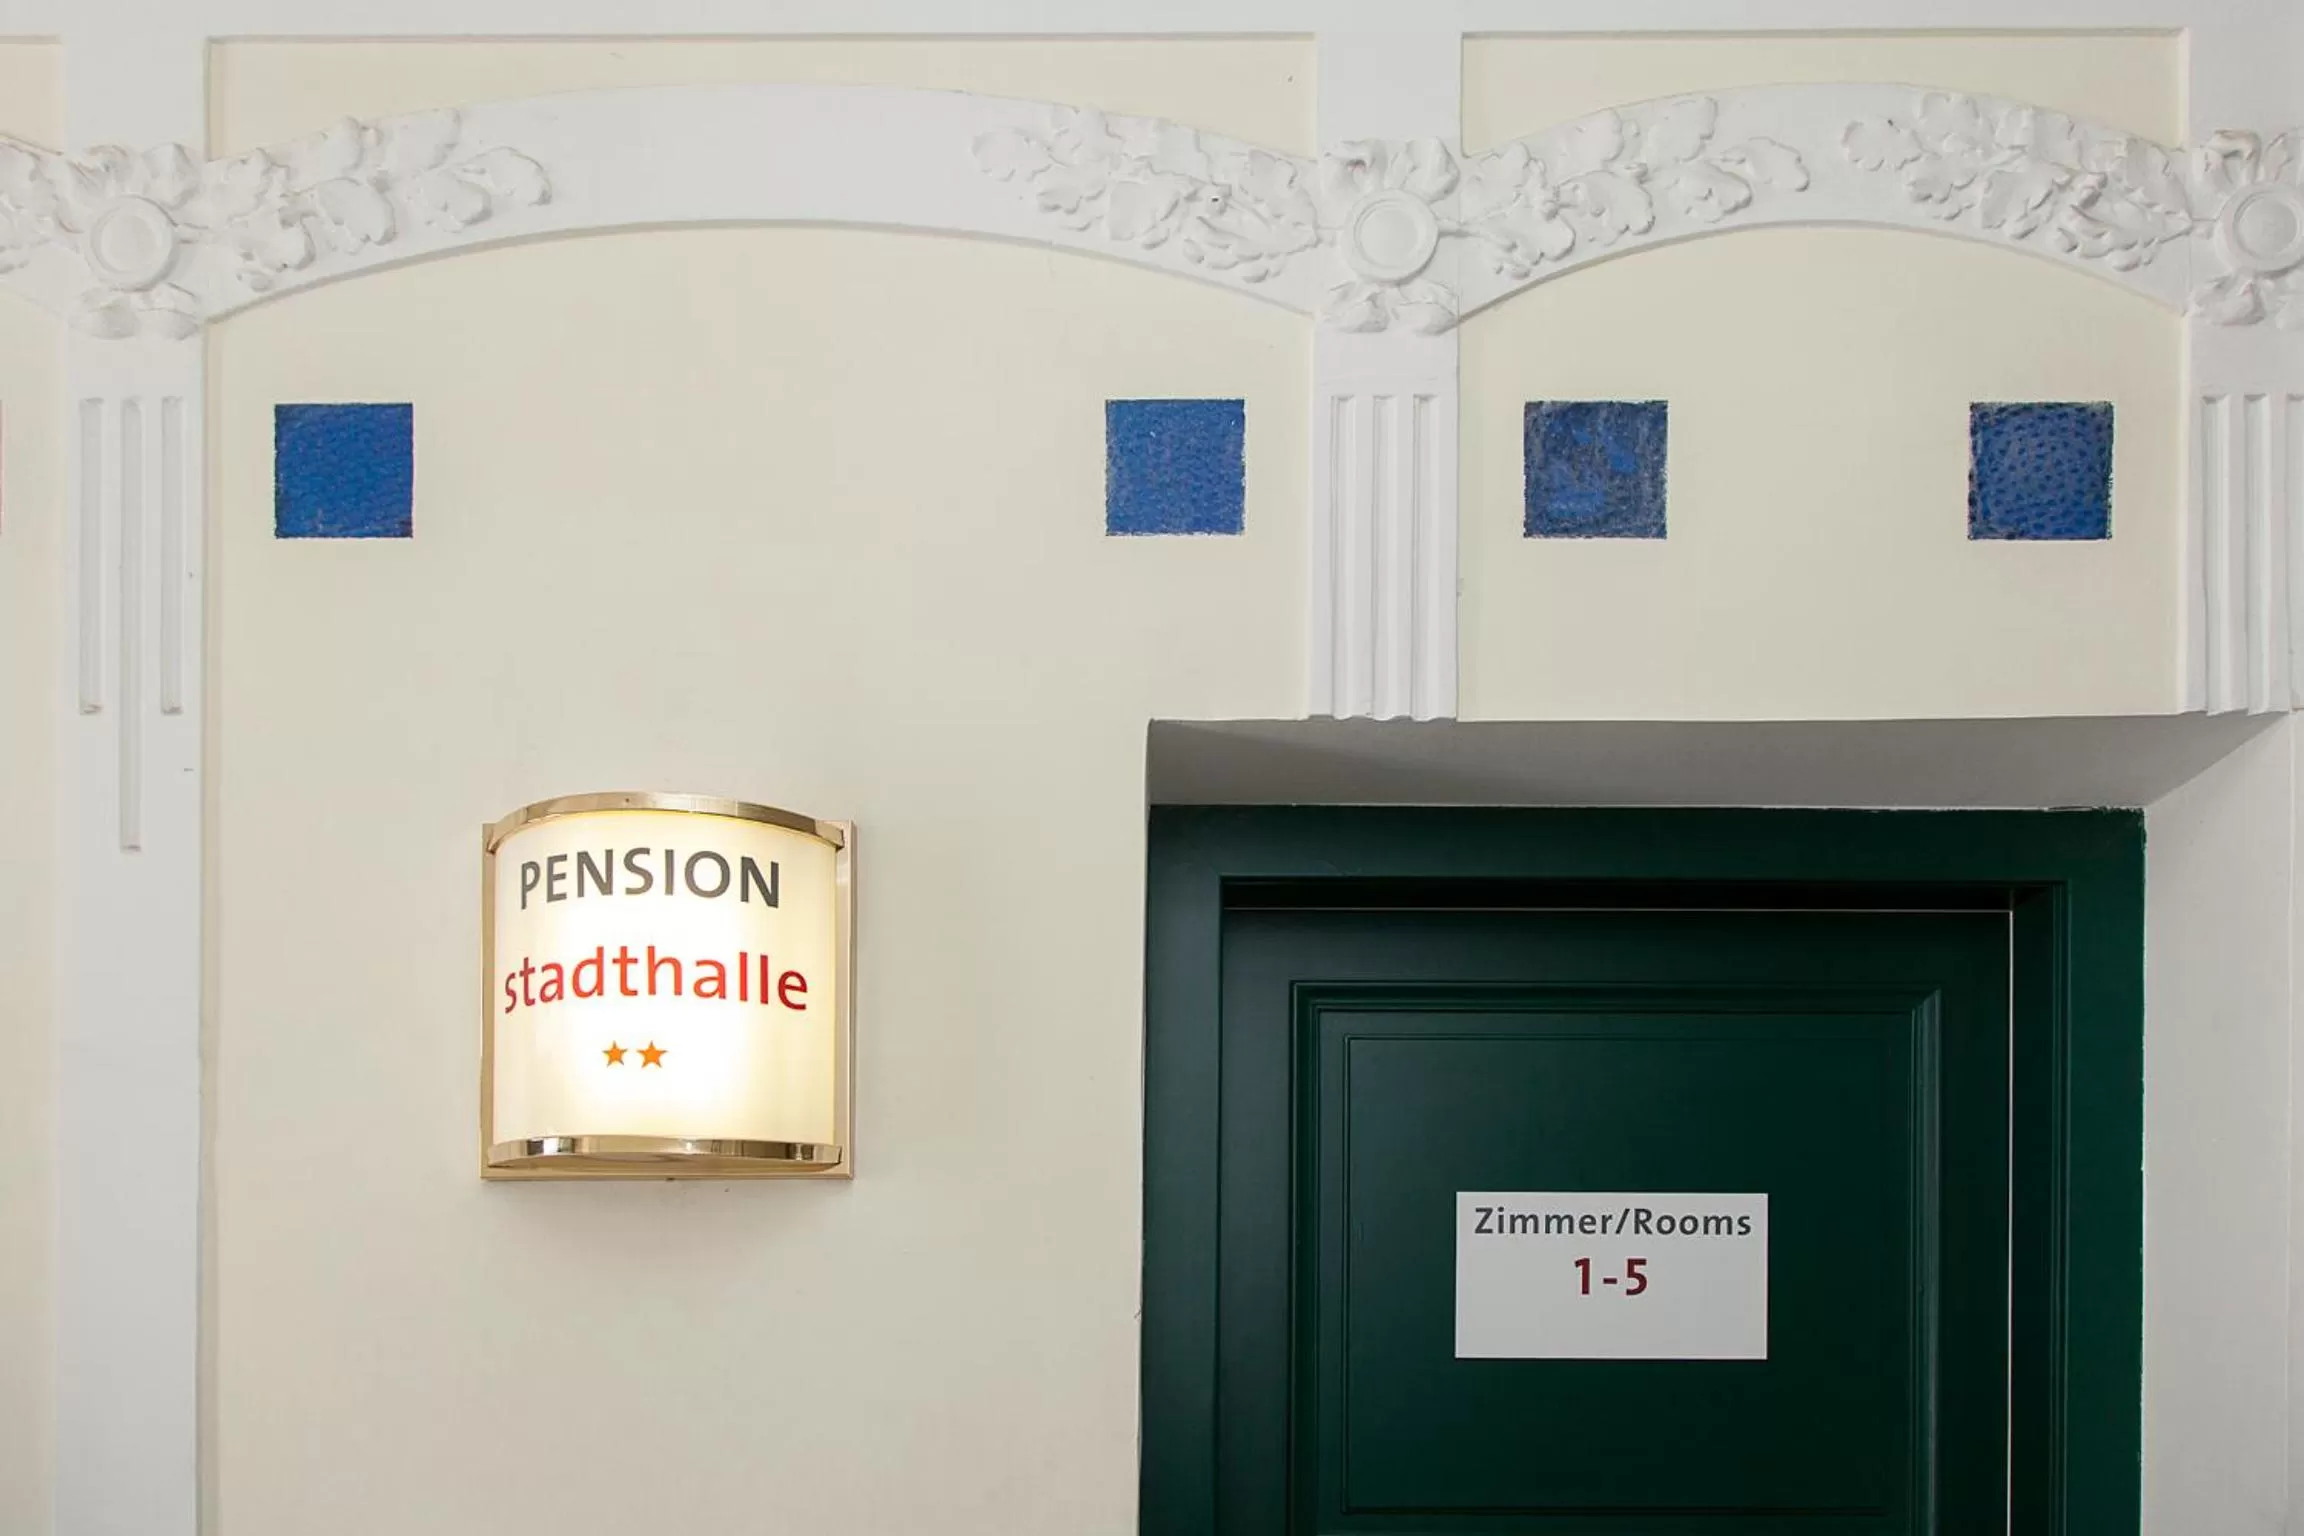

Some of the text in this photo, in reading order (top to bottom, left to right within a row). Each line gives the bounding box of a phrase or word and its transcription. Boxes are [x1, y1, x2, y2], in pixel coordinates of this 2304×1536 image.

[521, 847, 780, 910] PENSION
[504, 944, 808, 1014] stadthalle
[1474, 1206, 1752, 1236] Zimmer/Rooms
[1573, 1257, 1648, 1297] 1-5
